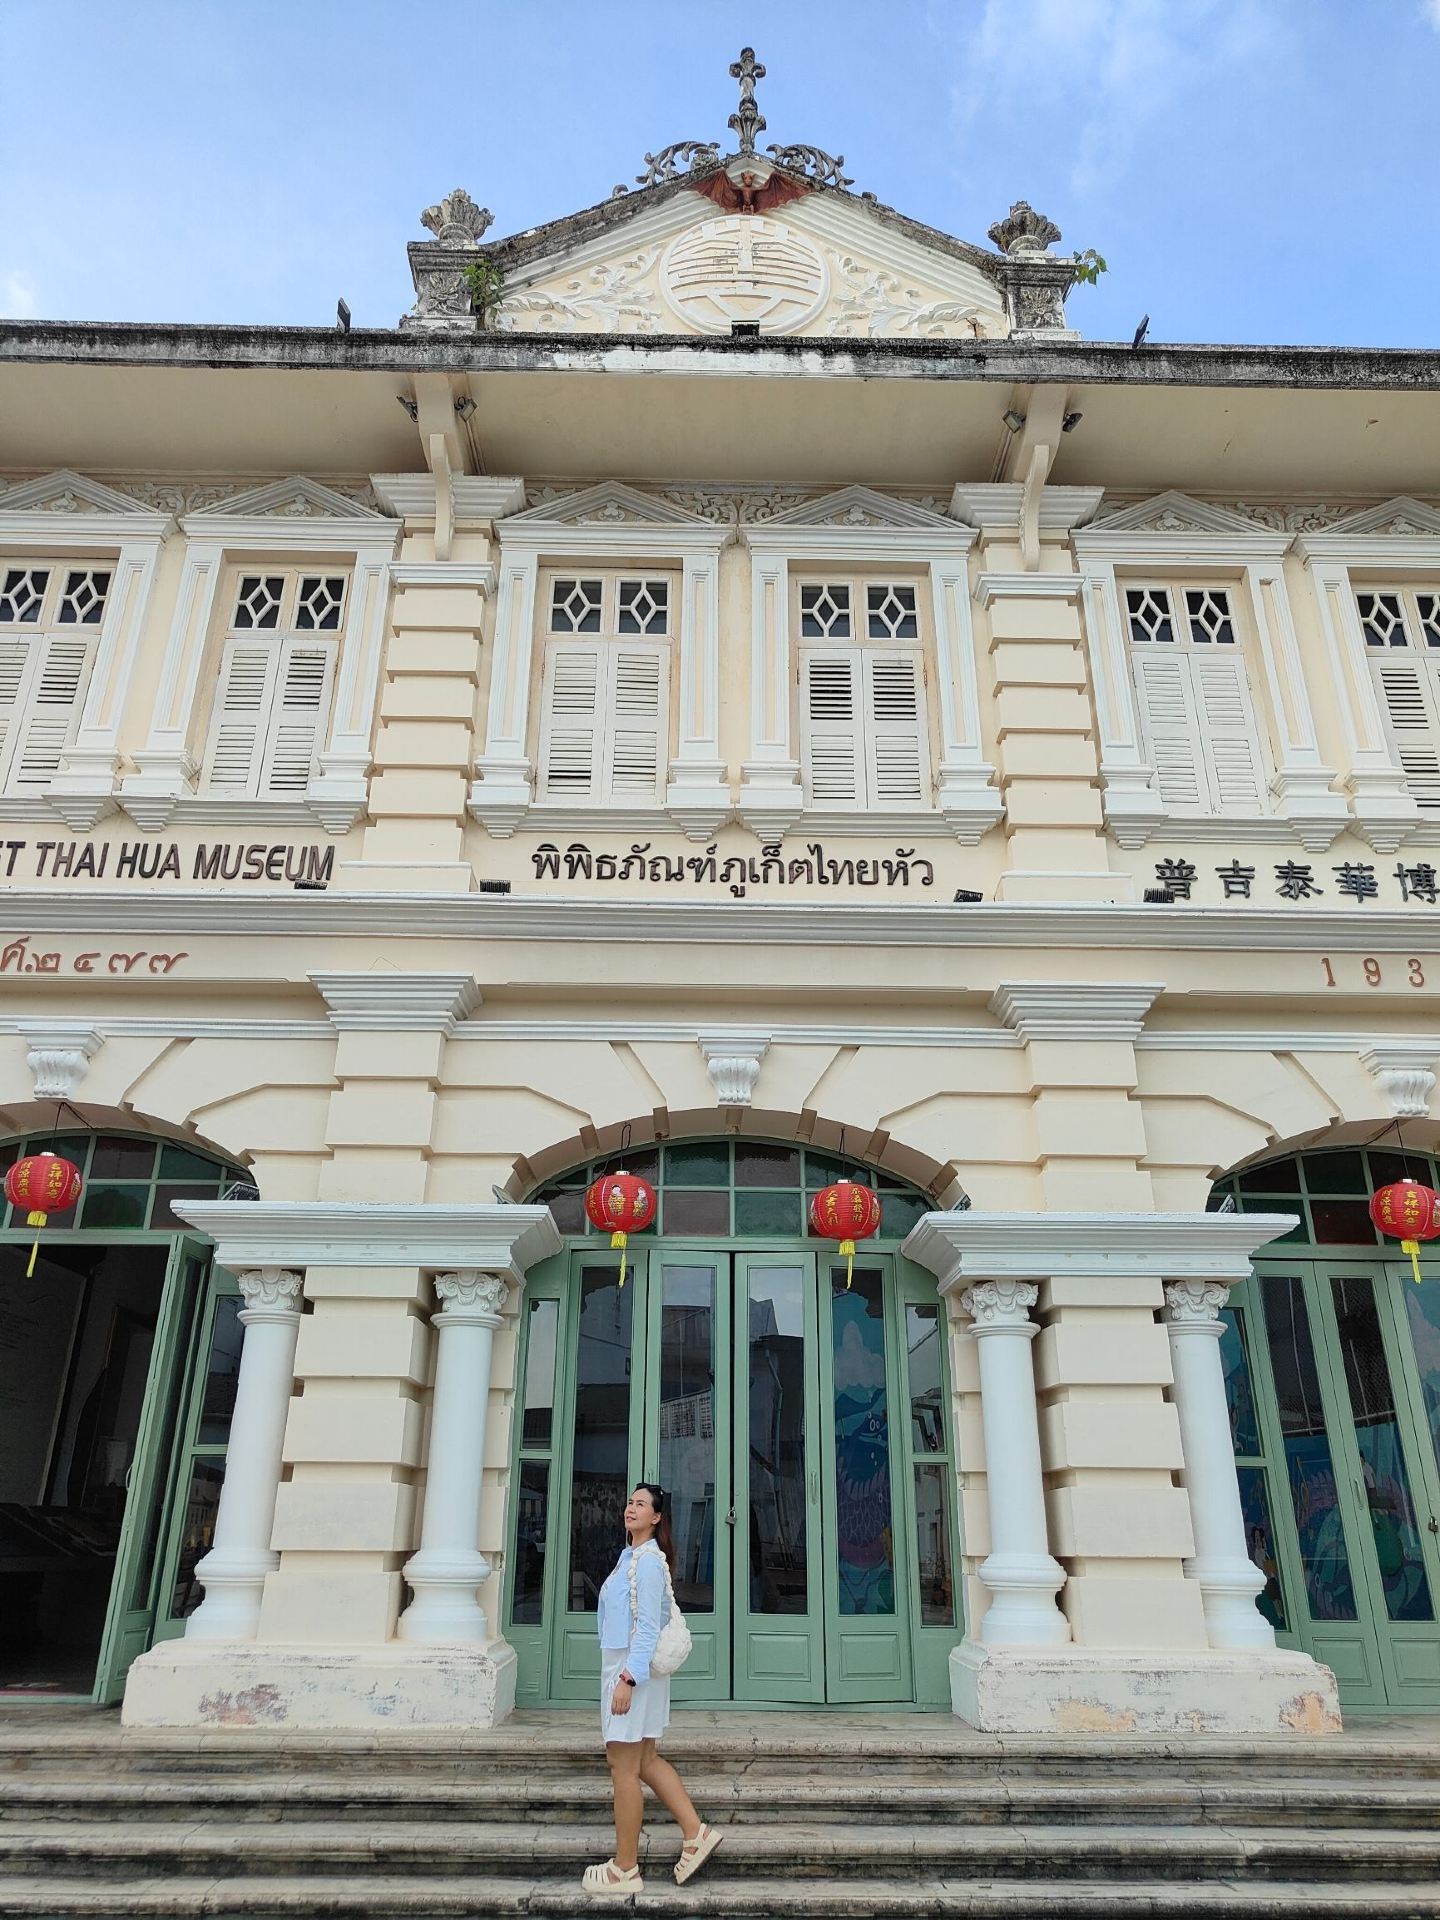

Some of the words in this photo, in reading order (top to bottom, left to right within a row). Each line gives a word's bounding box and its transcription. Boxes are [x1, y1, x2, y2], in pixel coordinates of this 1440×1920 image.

[0, 841, 26, 877] T
[36, 842, 110, 877] THAI
[116, 842, 181, 879] HUA
[193, 843, 335, 881] MUSEUM
[531, 842, 934, 898] พิพิธภัณฑ์ภูเก็ตไทยหัว
[1154, 857, 1440, 904] 普吉泰華博
